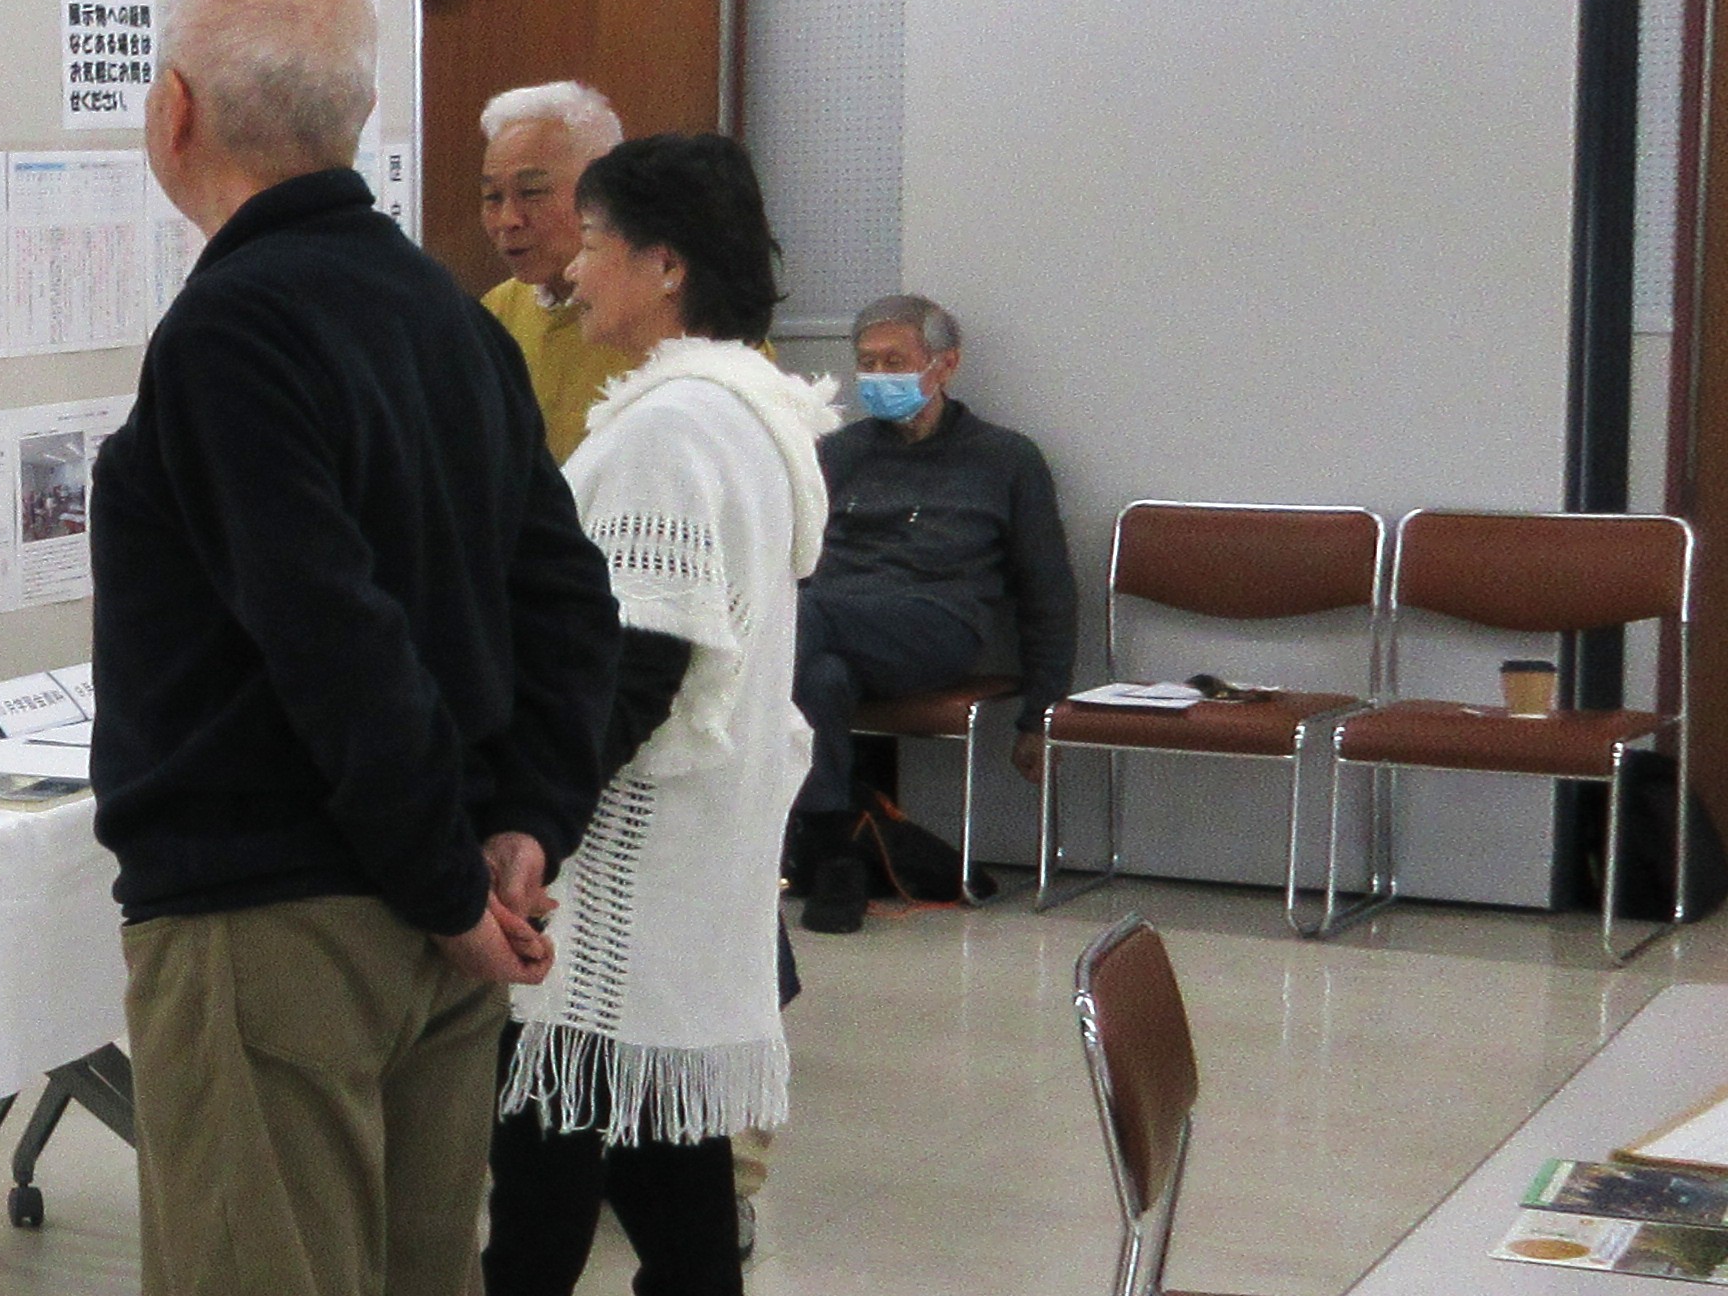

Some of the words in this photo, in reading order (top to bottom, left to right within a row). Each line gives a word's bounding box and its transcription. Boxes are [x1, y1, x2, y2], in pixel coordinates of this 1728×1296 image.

[69, 32, 151, 56] などある場合は
[70, 60, 152, 83] お気軽にお問合
